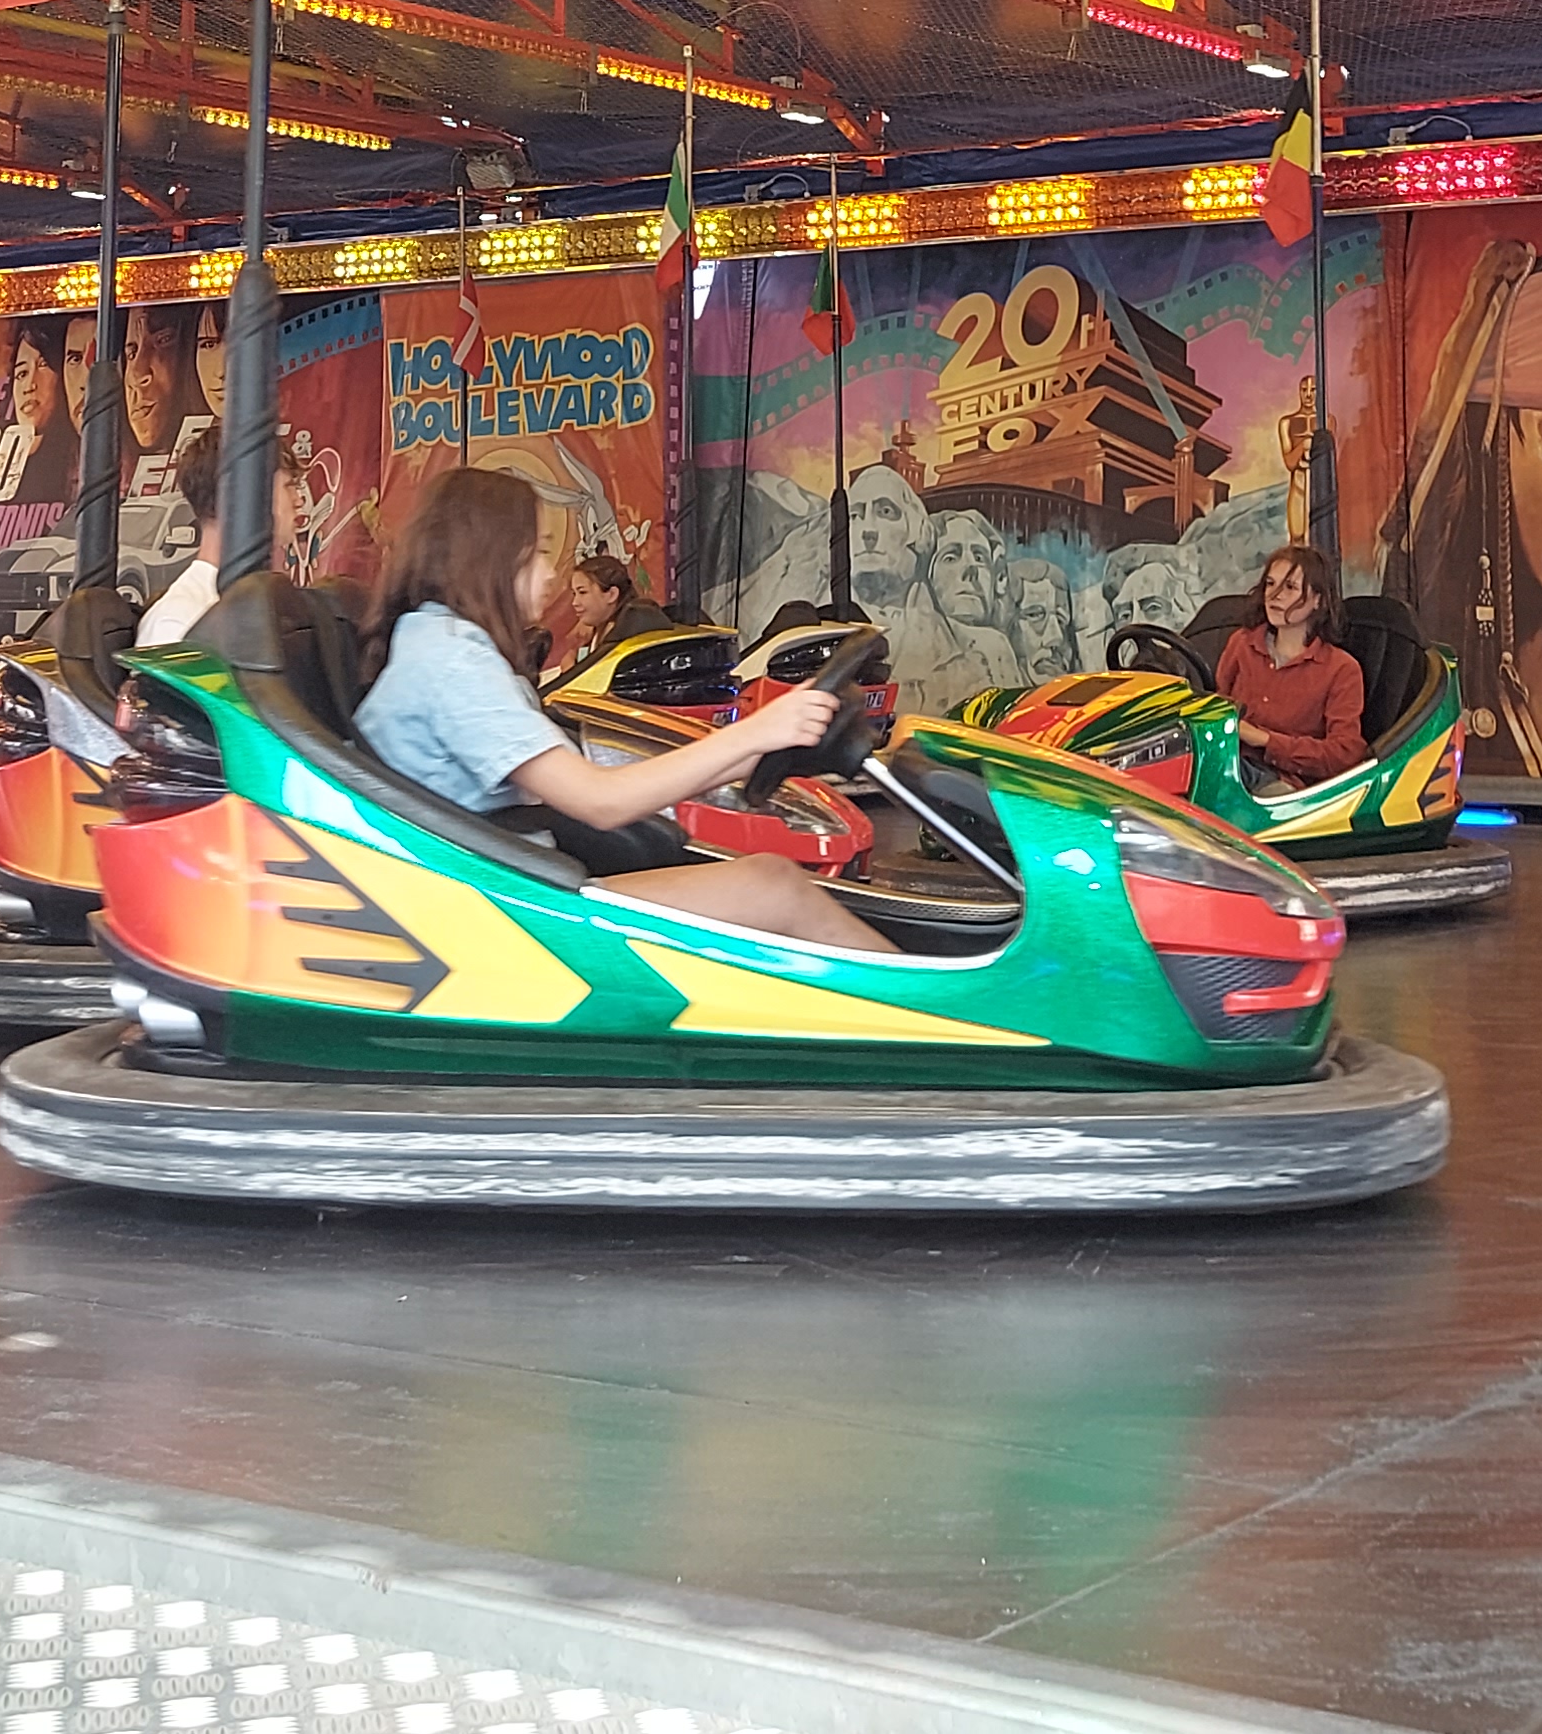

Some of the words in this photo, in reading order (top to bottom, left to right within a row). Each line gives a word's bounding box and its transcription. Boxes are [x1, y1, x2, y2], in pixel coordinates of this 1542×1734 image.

[389, 378, 656, 455] BOULEVARD
[941, 361, 1107, 427] CENTURY
[937, 395, 1107, 464] FOX
